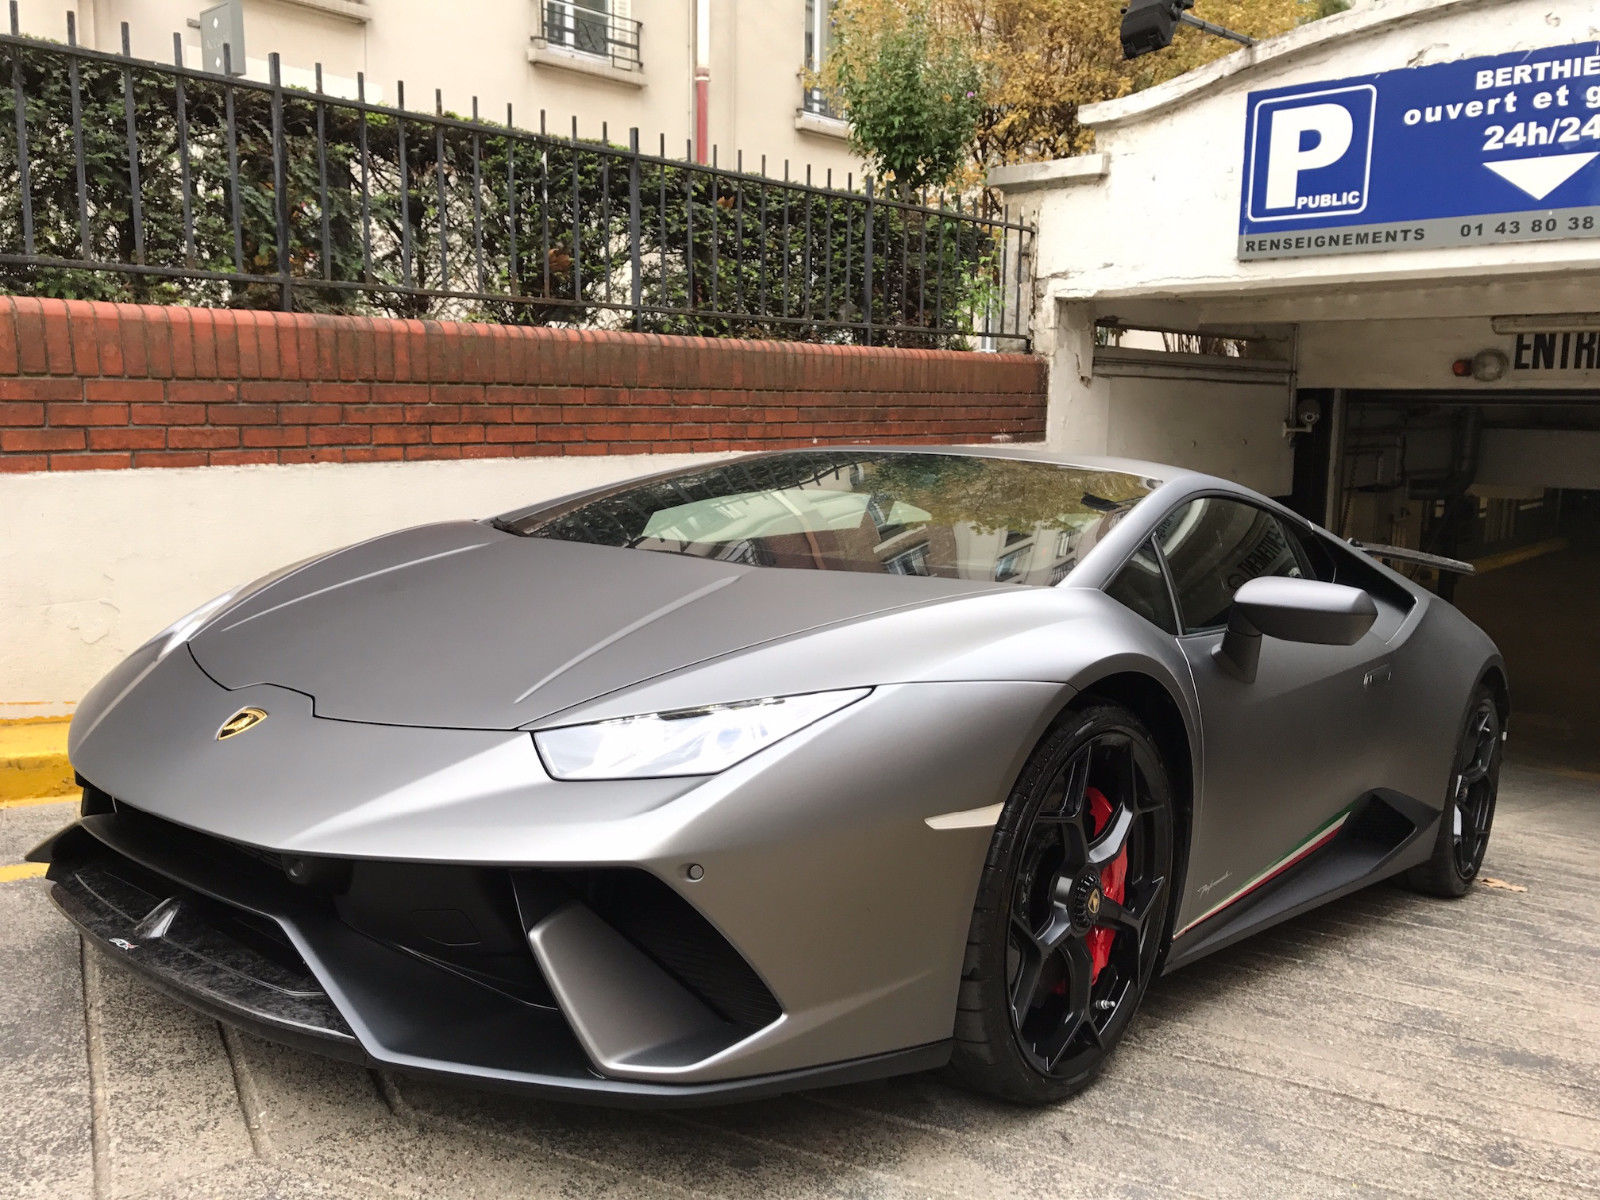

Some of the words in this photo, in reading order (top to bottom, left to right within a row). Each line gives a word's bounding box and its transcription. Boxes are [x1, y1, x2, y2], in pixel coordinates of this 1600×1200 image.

[1403, 91, 1517, 126] ouvert
[1532, 84, 1570, 109] et
[1482, 113, 1600, 151] 24h/24
[1265, 103, 1353, 209] P
[1297, 191, 1360, 209] PUBLIC
[1246, 228, 1425, 252] RENSEIGNEMENTS
[1460, 223, 1483, 238] 01
[1495, 221, 1520, 235] 43
[1531, 218, 1557, 233] 80
[1568, 216, 1594, 231] 38
